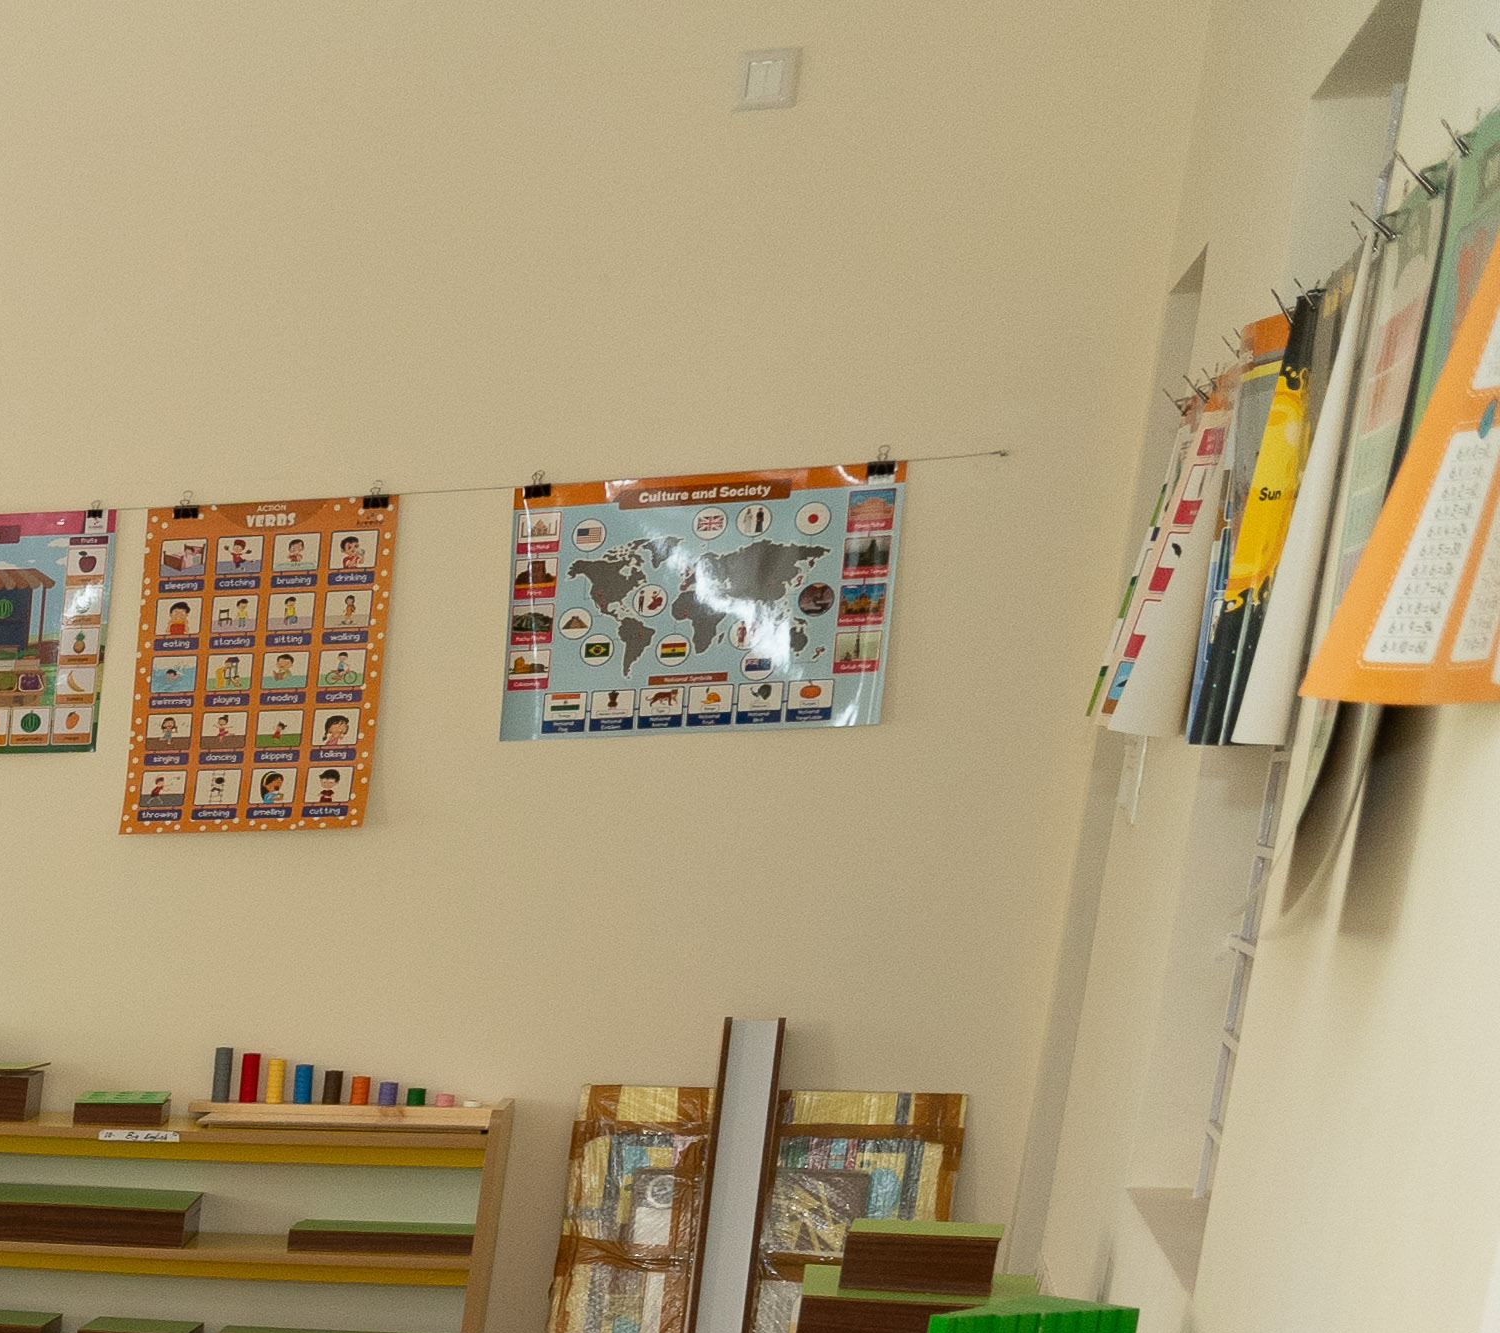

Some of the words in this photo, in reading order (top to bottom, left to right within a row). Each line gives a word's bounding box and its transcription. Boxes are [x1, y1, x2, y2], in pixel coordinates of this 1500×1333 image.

[639, 489, 689, 504] Culture
[691, 487, 716, 501] and
[719, 484, 771, 500] Society
[1259, 487, 1281, 501] Sun
[257, 504, 286, 512] ACTION
[246, 512, 296, 528] VERBS
[219, 578, 255, 588] catching
[276, 575, 312, 586] brushing
[335, 573, 367, 583] drinking
[164, 580, 198, 591] sleeping
[213, 636, 250, 647] standing
[273, 634, 303, 645] sitting
[330, 632, 361, 642] walking
[162, 639, 190, 650] eating
[151, 697, 192, 706] swimming
[213, 696, 241, 706] playing
[267, 693, 298, 704] reading
[325, 692, 353, 702] cycling
[153, 754, 180, 764] singing
[205, 753, 237, 763] dancing
[260, 751, 293, 762] skipping
[319, 749, 347, 760] talking
[142, 809, 178, 820] throwing
[198, 808, 230, 818] climbing
[253, 808, 286, 817] smelling
[309, 806, 341, 816] cutting
